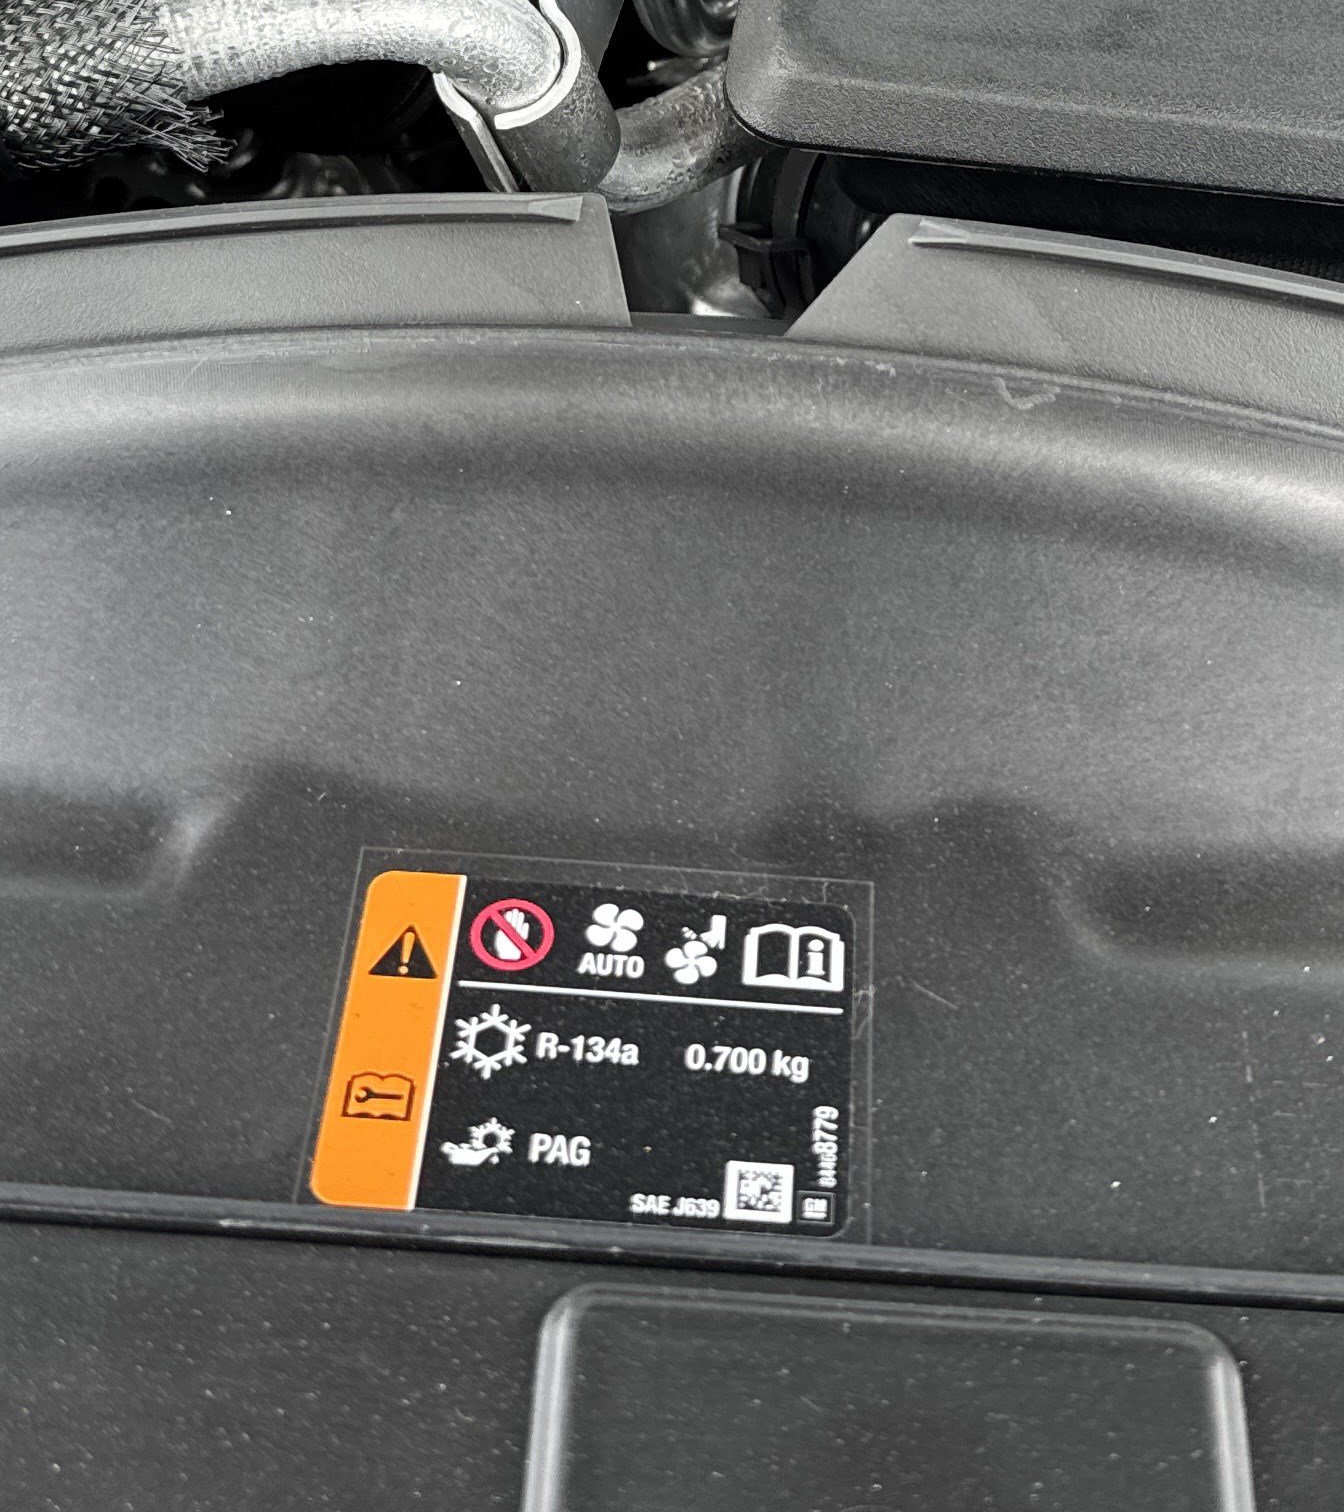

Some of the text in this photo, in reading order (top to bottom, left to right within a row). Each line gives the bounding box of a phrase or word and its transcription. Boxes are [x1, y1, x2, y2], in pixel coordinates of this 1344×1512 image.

[578, 953, 644, 979] AUTO
[536, 1032, 810, 1084] R-134a 0.700 kg
[528, 1132, 591, 1167] PAG
[630, 1193, 721, 1219] SAE J639
